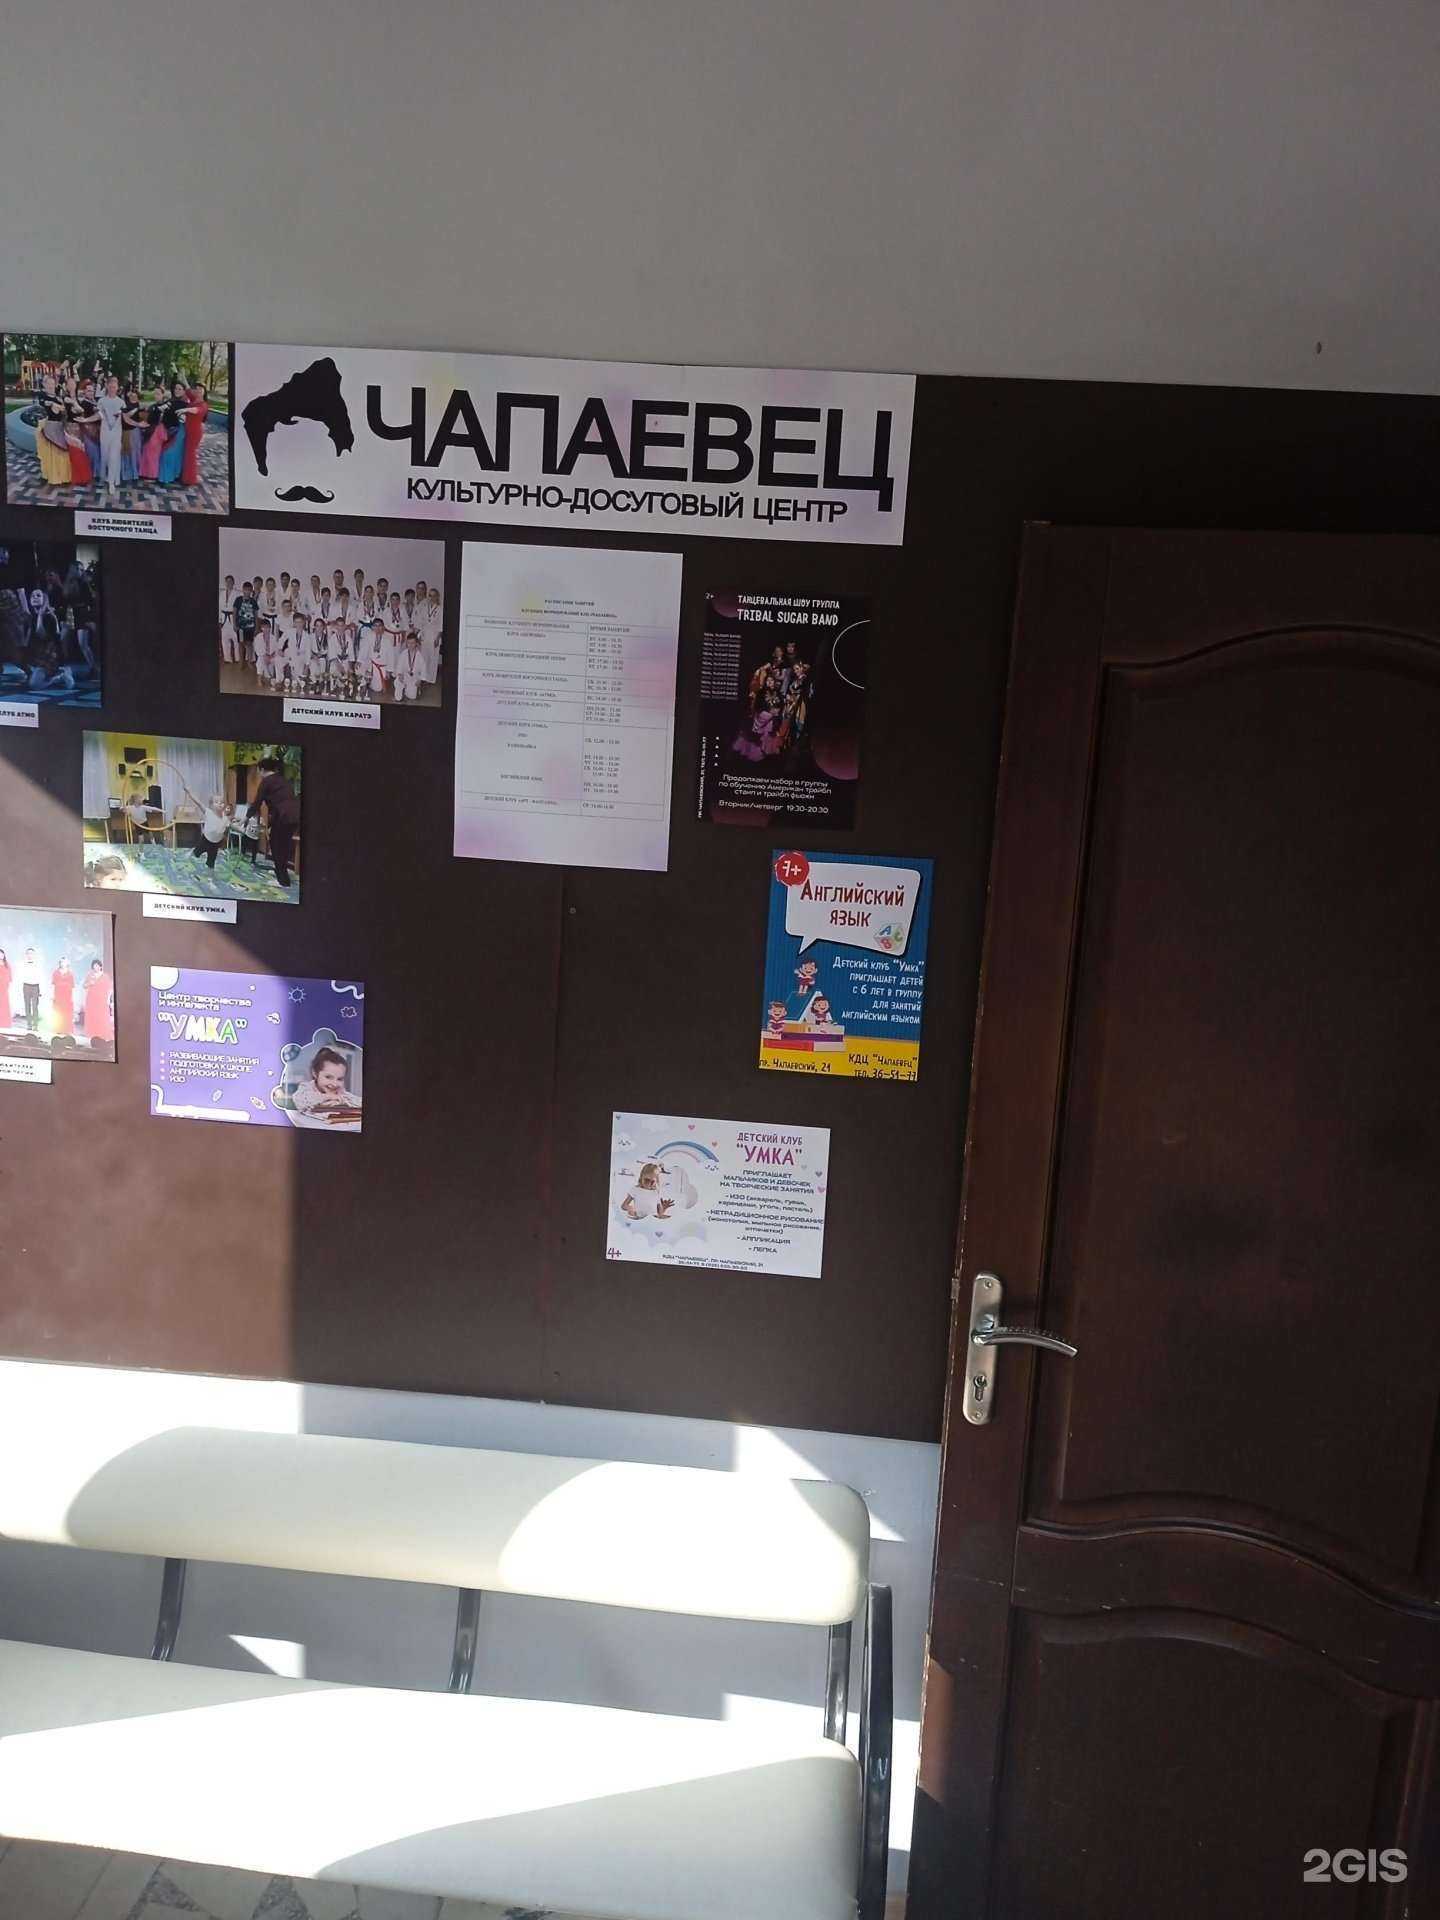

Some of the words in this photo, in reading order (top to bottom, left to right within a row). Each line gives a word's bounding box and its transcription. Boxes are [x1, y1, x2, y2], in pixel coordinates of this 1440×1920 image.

[366, 385, 894, 512] ЧАПАЕВЕЦ
[407, 478, 743, 519] КУЛЬТУРНО-ДОСУГОВЫЙ
[753, 497, 848, 524] ЦЕНТР
[88, 524, 133, 532] ВОСТОЧНОГО
[738, 595, 792, 606] ТАНЦЕВАЛЬНАЯ
[793, 599, 810, 607] ШОУ
[812, 600, 840, 609] ГРУППА
[737, 608, 774, 622] TRIBAL
[777, 611, 808, 624] SUGAR
[811, 613, 838, 626] BAND
[291, 707, 324, 715] ДЕТСКИЙ
[325, 709, 343, 717] КЛУБ
[345, 711, 372, 719] КАРАТЭ
[770, 777, 793, 786] набор
[782, 860, 801, 877] 7+
[830, 910, 871, 927] ЯЗЫК
[849, 973, 896, 984] ПРИГЛАШАЕТ
[900, 976, 923, 987] ДЕТЕЙ
[861, 984, 868, 994] 6
[872, 1000, 889, 1010] ДЛЯ
[841, 1010, 888, 1021] АНГЛИЙСКИМ
[849, 1054, 869, 1065] КДЦ
[737, 1132, 778, 1143] ДЕТСКИЙ
[781, 1135, 802, 1146] КЛУБ
[736, 1143, 802, 1166] "УМКА"
[743, 1169, 792, 1179] ПРИГЛАШАЕТ
[723, 1175, 769, 1183] МАЛЬЧИКОВ
[777, 1180, 811, 1188] ДЕВОЧЕК
[732, 1183, 779, 1191] ТВОРЧЕСКИЕ
[781, 1186, 814, 1194] ЗАНЯТИЯ
[710, 1209, 779, 1220] НЕТРАДИЦИОННОЕ
[742, 1236, 790, 1244] АППЛИКАЦИЯ
[608, 1247, 622, 1258] 4+
